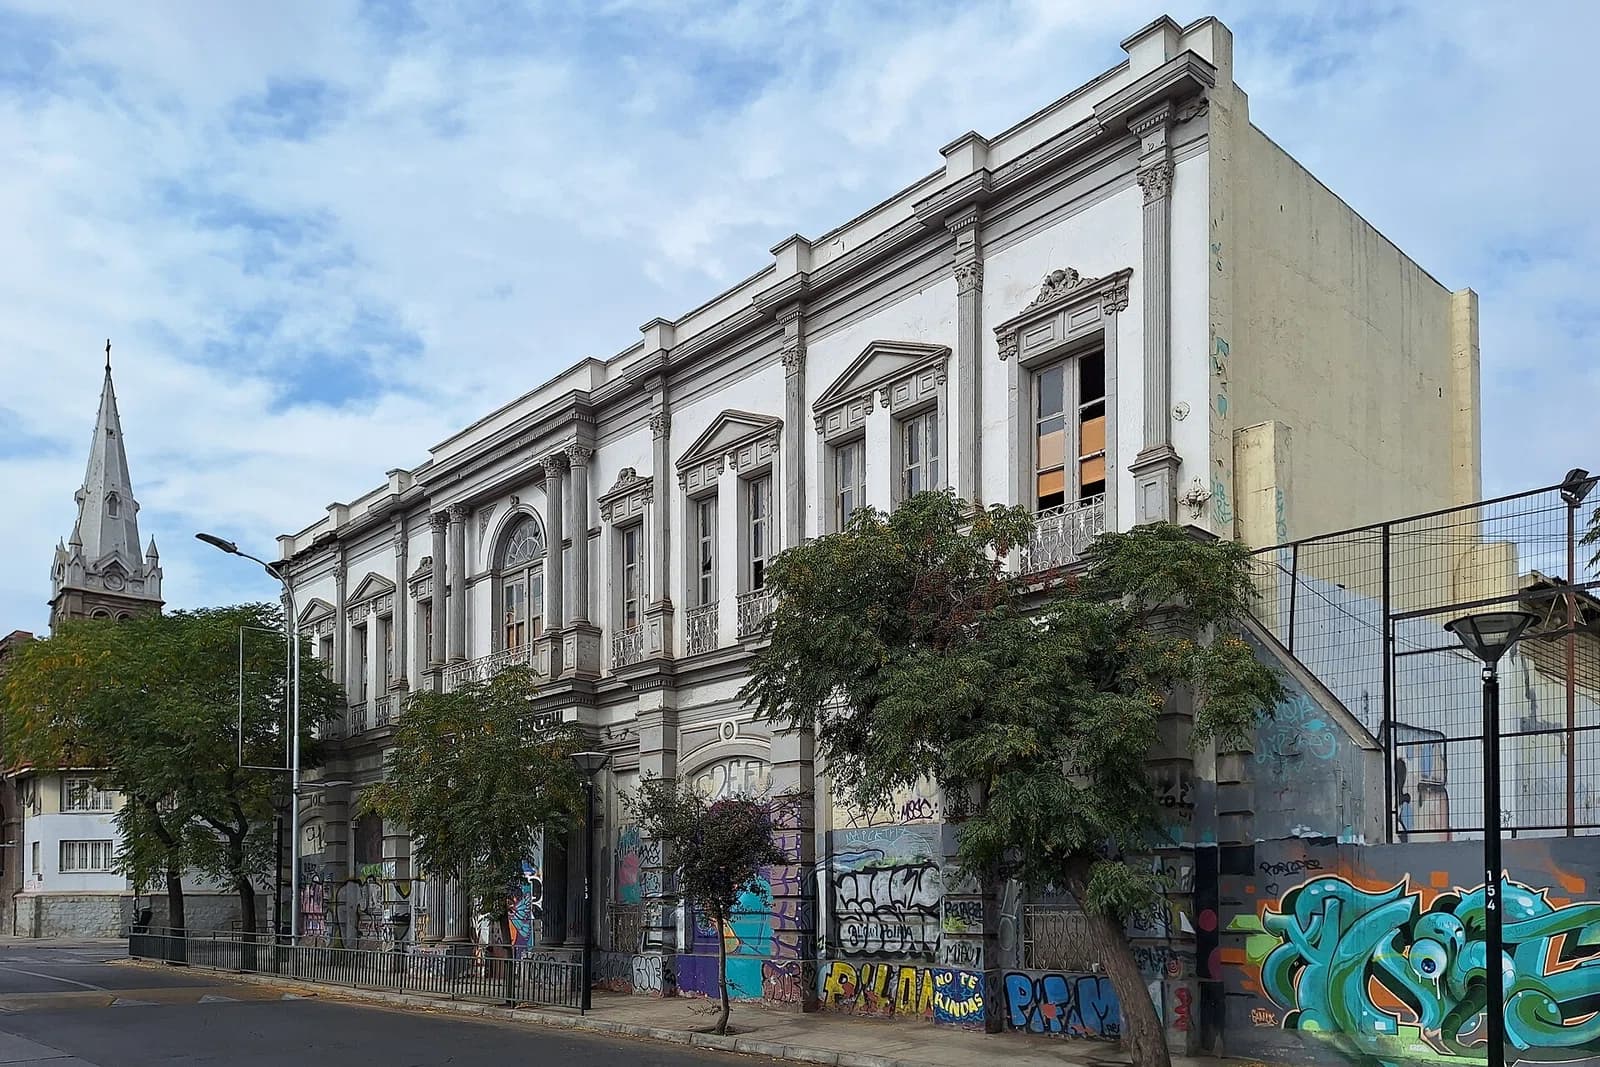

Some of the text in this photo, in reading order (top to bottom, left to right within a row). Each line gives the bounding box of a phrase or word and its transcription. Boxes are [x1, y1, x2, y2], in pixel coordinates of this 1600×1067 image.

[1486, 870, 1496, 911] 154
[935, 971, 979, 990] NO TE
[933, 991, 984, 1018] RINDAS
